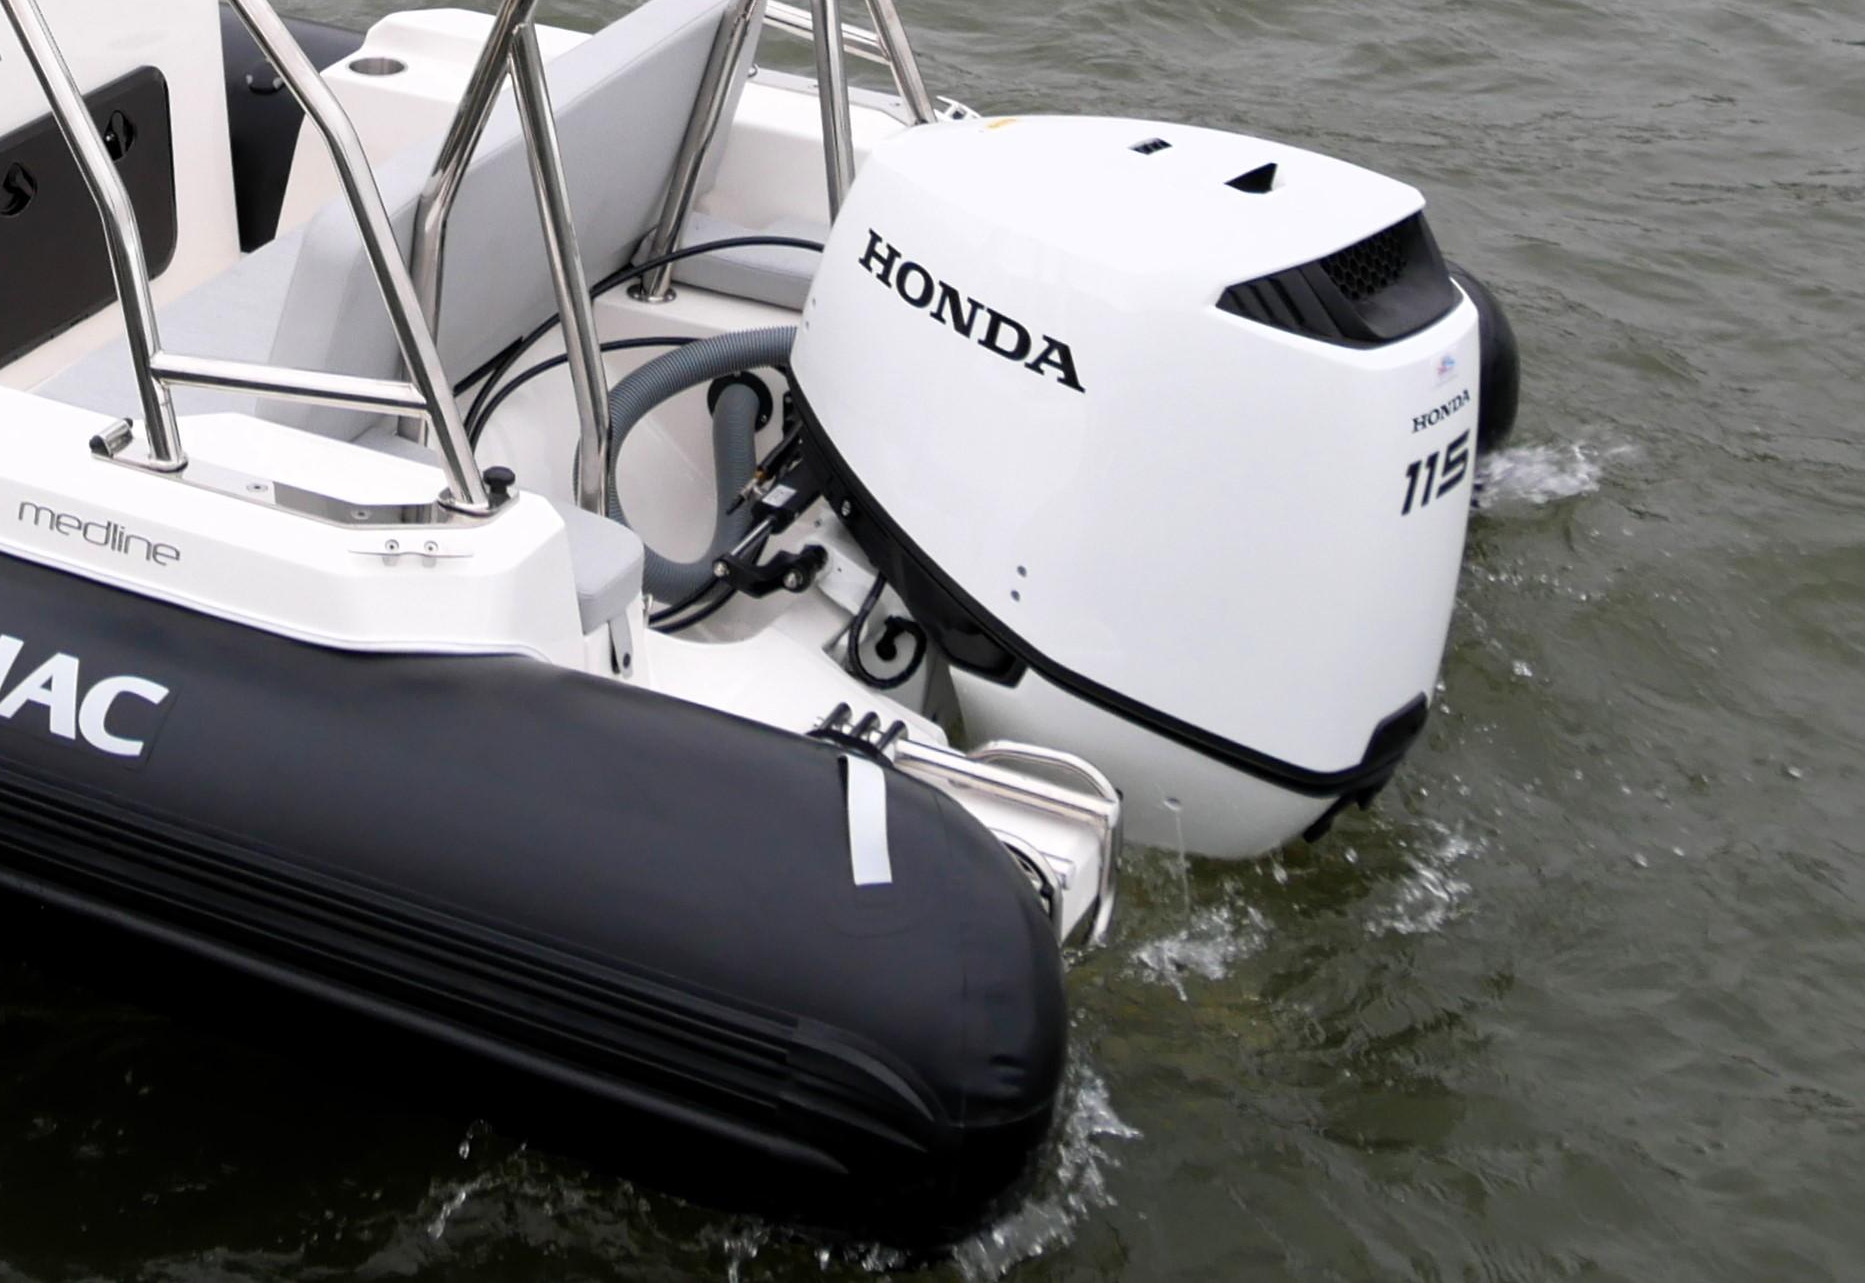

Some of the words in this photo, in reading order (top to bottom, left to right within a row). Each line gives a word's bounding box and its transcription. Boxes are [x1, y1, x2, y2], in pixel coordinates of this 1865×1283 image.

[858, 228, 1086, 394] HONDA
[1411, 389, 1471, 433] HONDA
[1401, 429, 1471, 516] 115
[18, 501, 181, 567] medline
